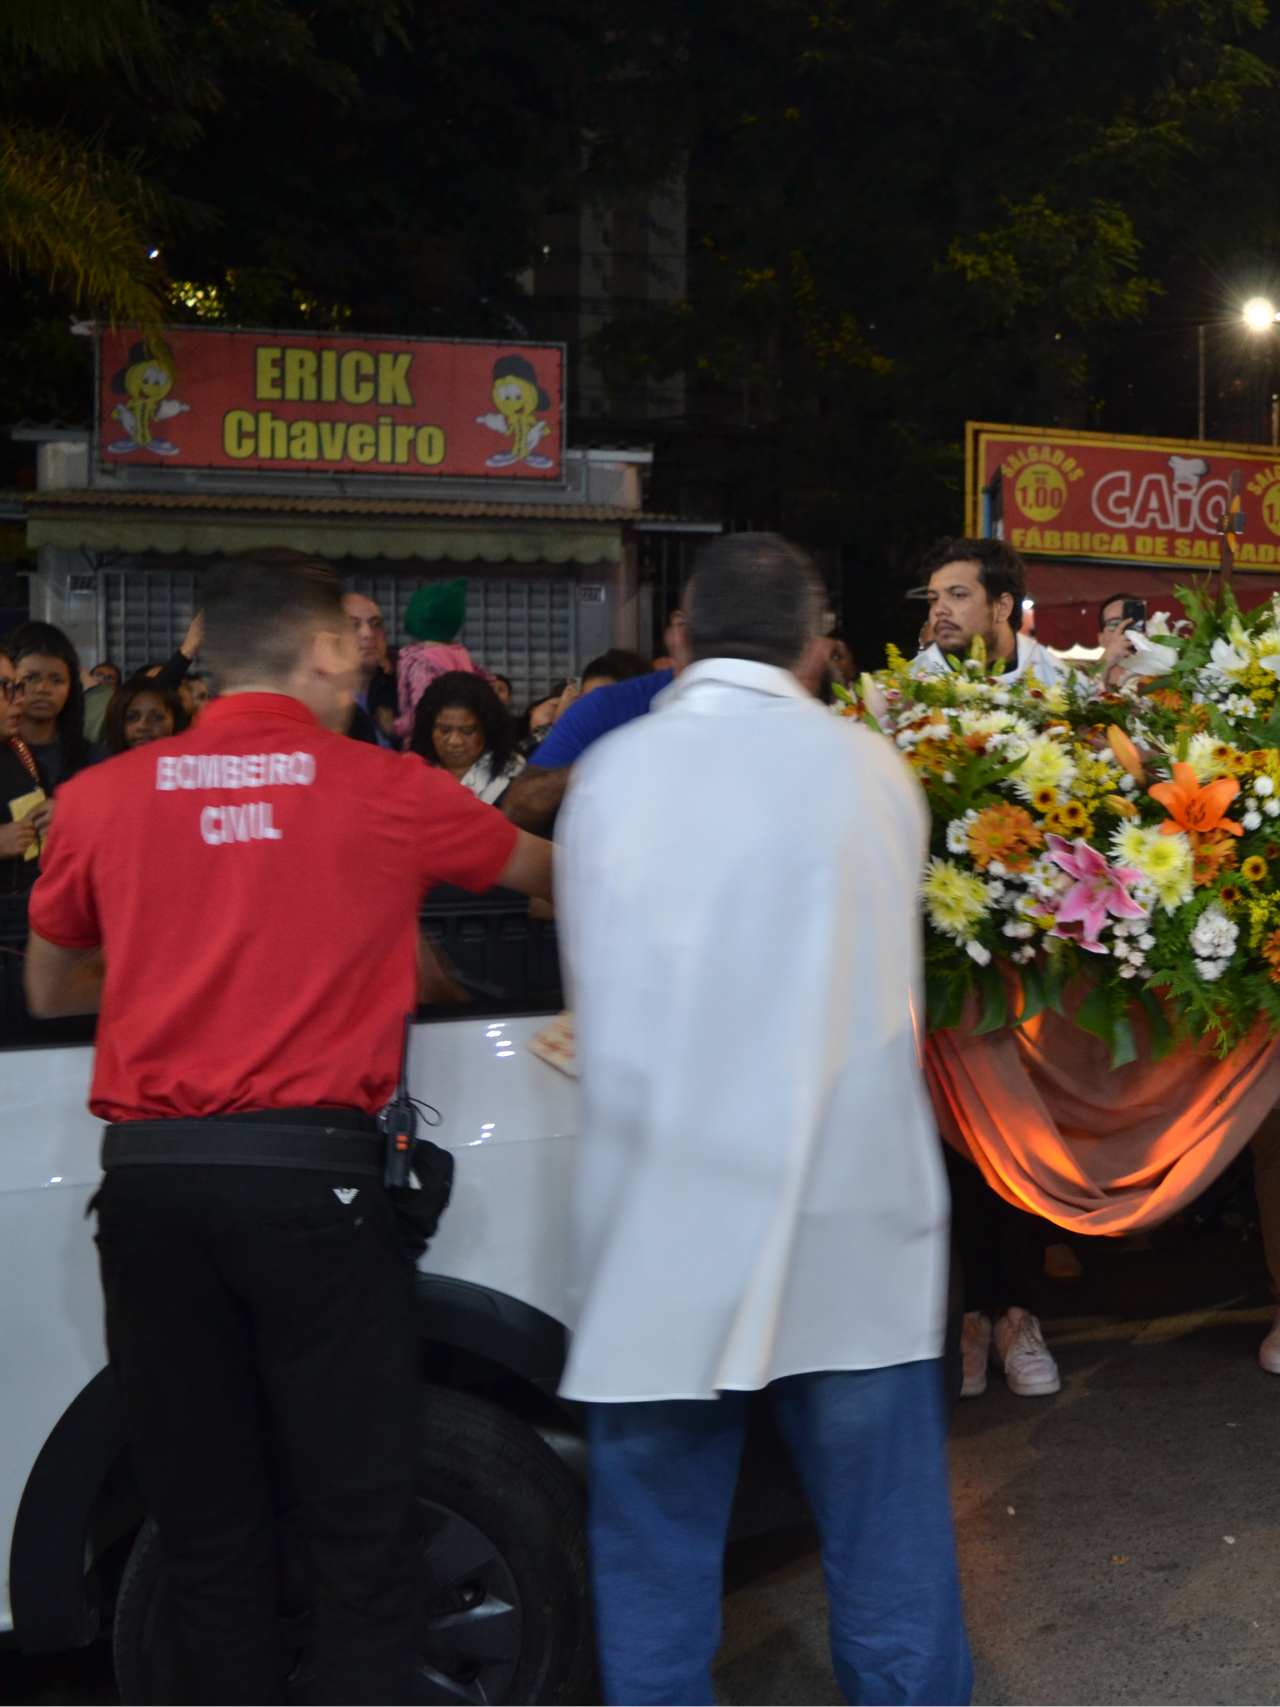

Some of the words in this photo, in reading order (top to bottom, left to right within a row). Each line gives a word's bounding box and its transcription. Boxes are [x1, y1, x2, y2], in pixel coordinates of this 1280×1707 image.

[253, 347, 413, 405] ERICK
[223, 410, 446, 465] Chaveiro
[1001, 446, 1084, 482] SALGADOS
[1011, 527, 1129, 554] FÁBRICA
[1135, 535, 1168, 555] DE
[156, 752, 316, 790] BOMBEIRO
[201, 802, 282, 845] CIVIL
